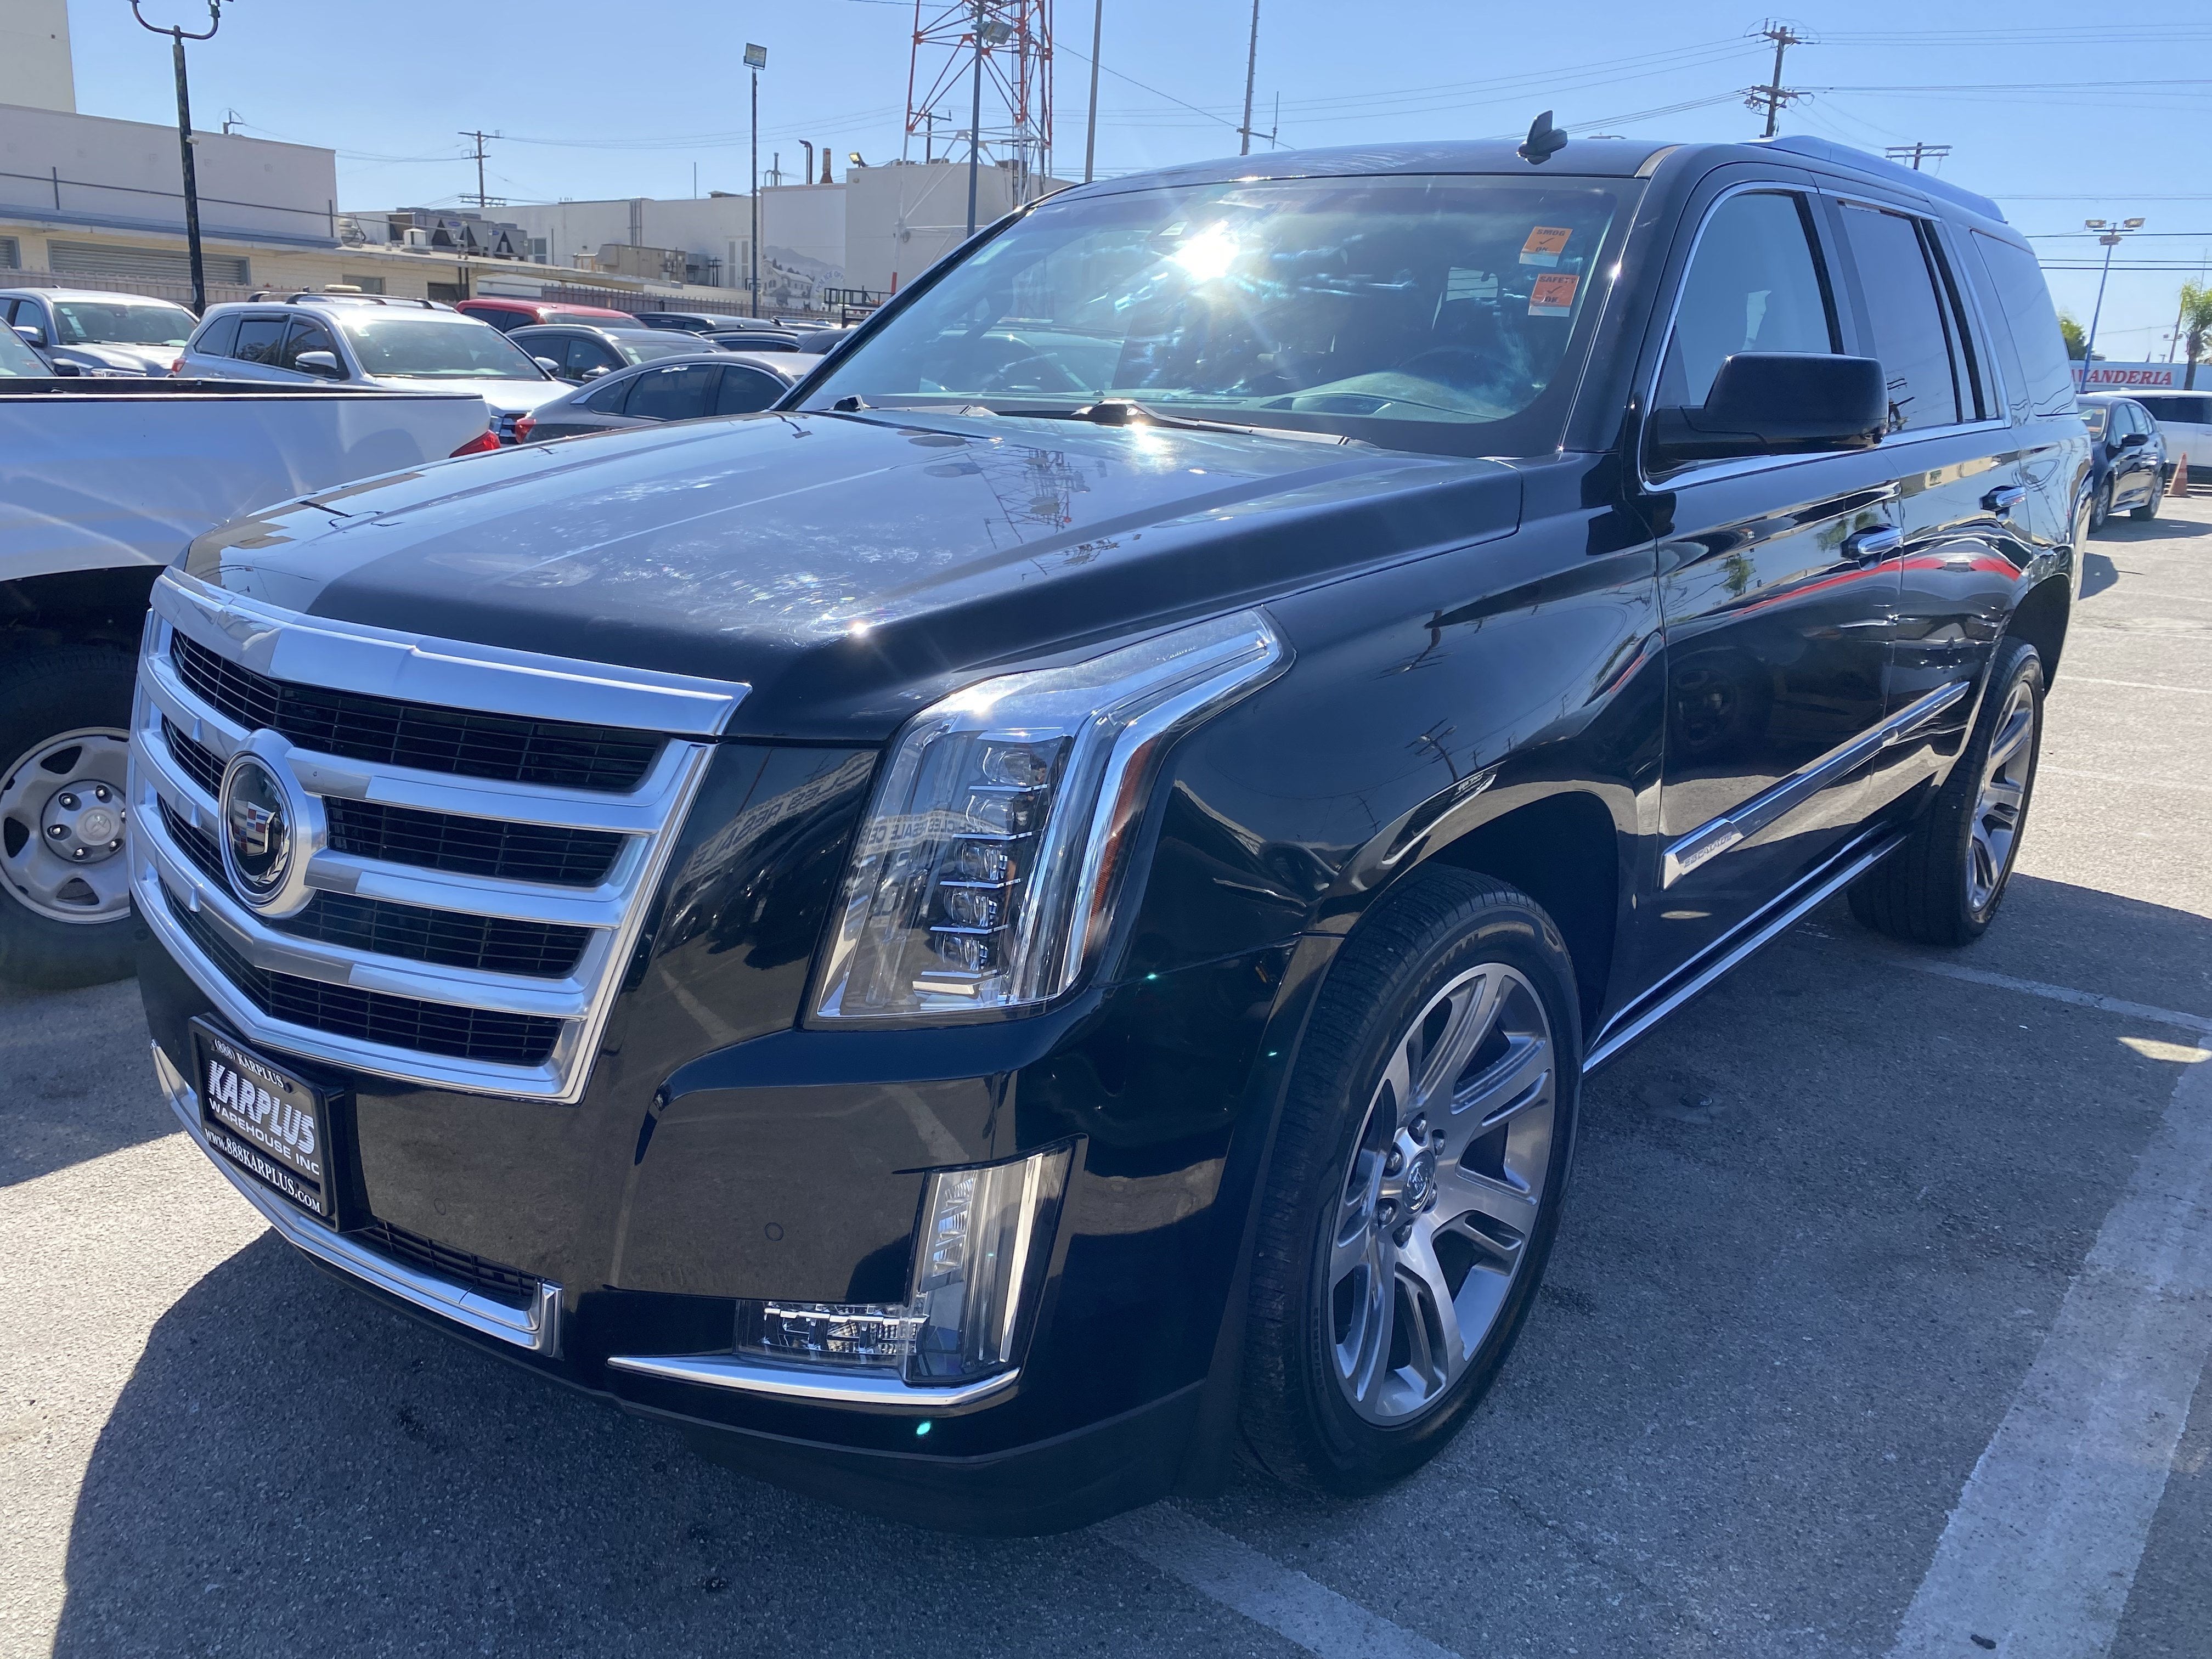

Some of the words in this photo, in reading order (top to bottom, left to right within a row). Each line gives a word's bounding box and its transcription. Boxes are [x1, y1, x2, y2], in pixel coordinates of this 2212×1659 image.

[1683, 831, 1733, 868] ESCALADE
[215, 1039, 235, 1060] (888)
[236, 1053, 284, 1088] KARPLUS
[208, 1059, 315, 1154] KARPLUS
[209, 1098, 291, 1159] WAREHOUSE
[296, 1153, 320, 1175] INC
